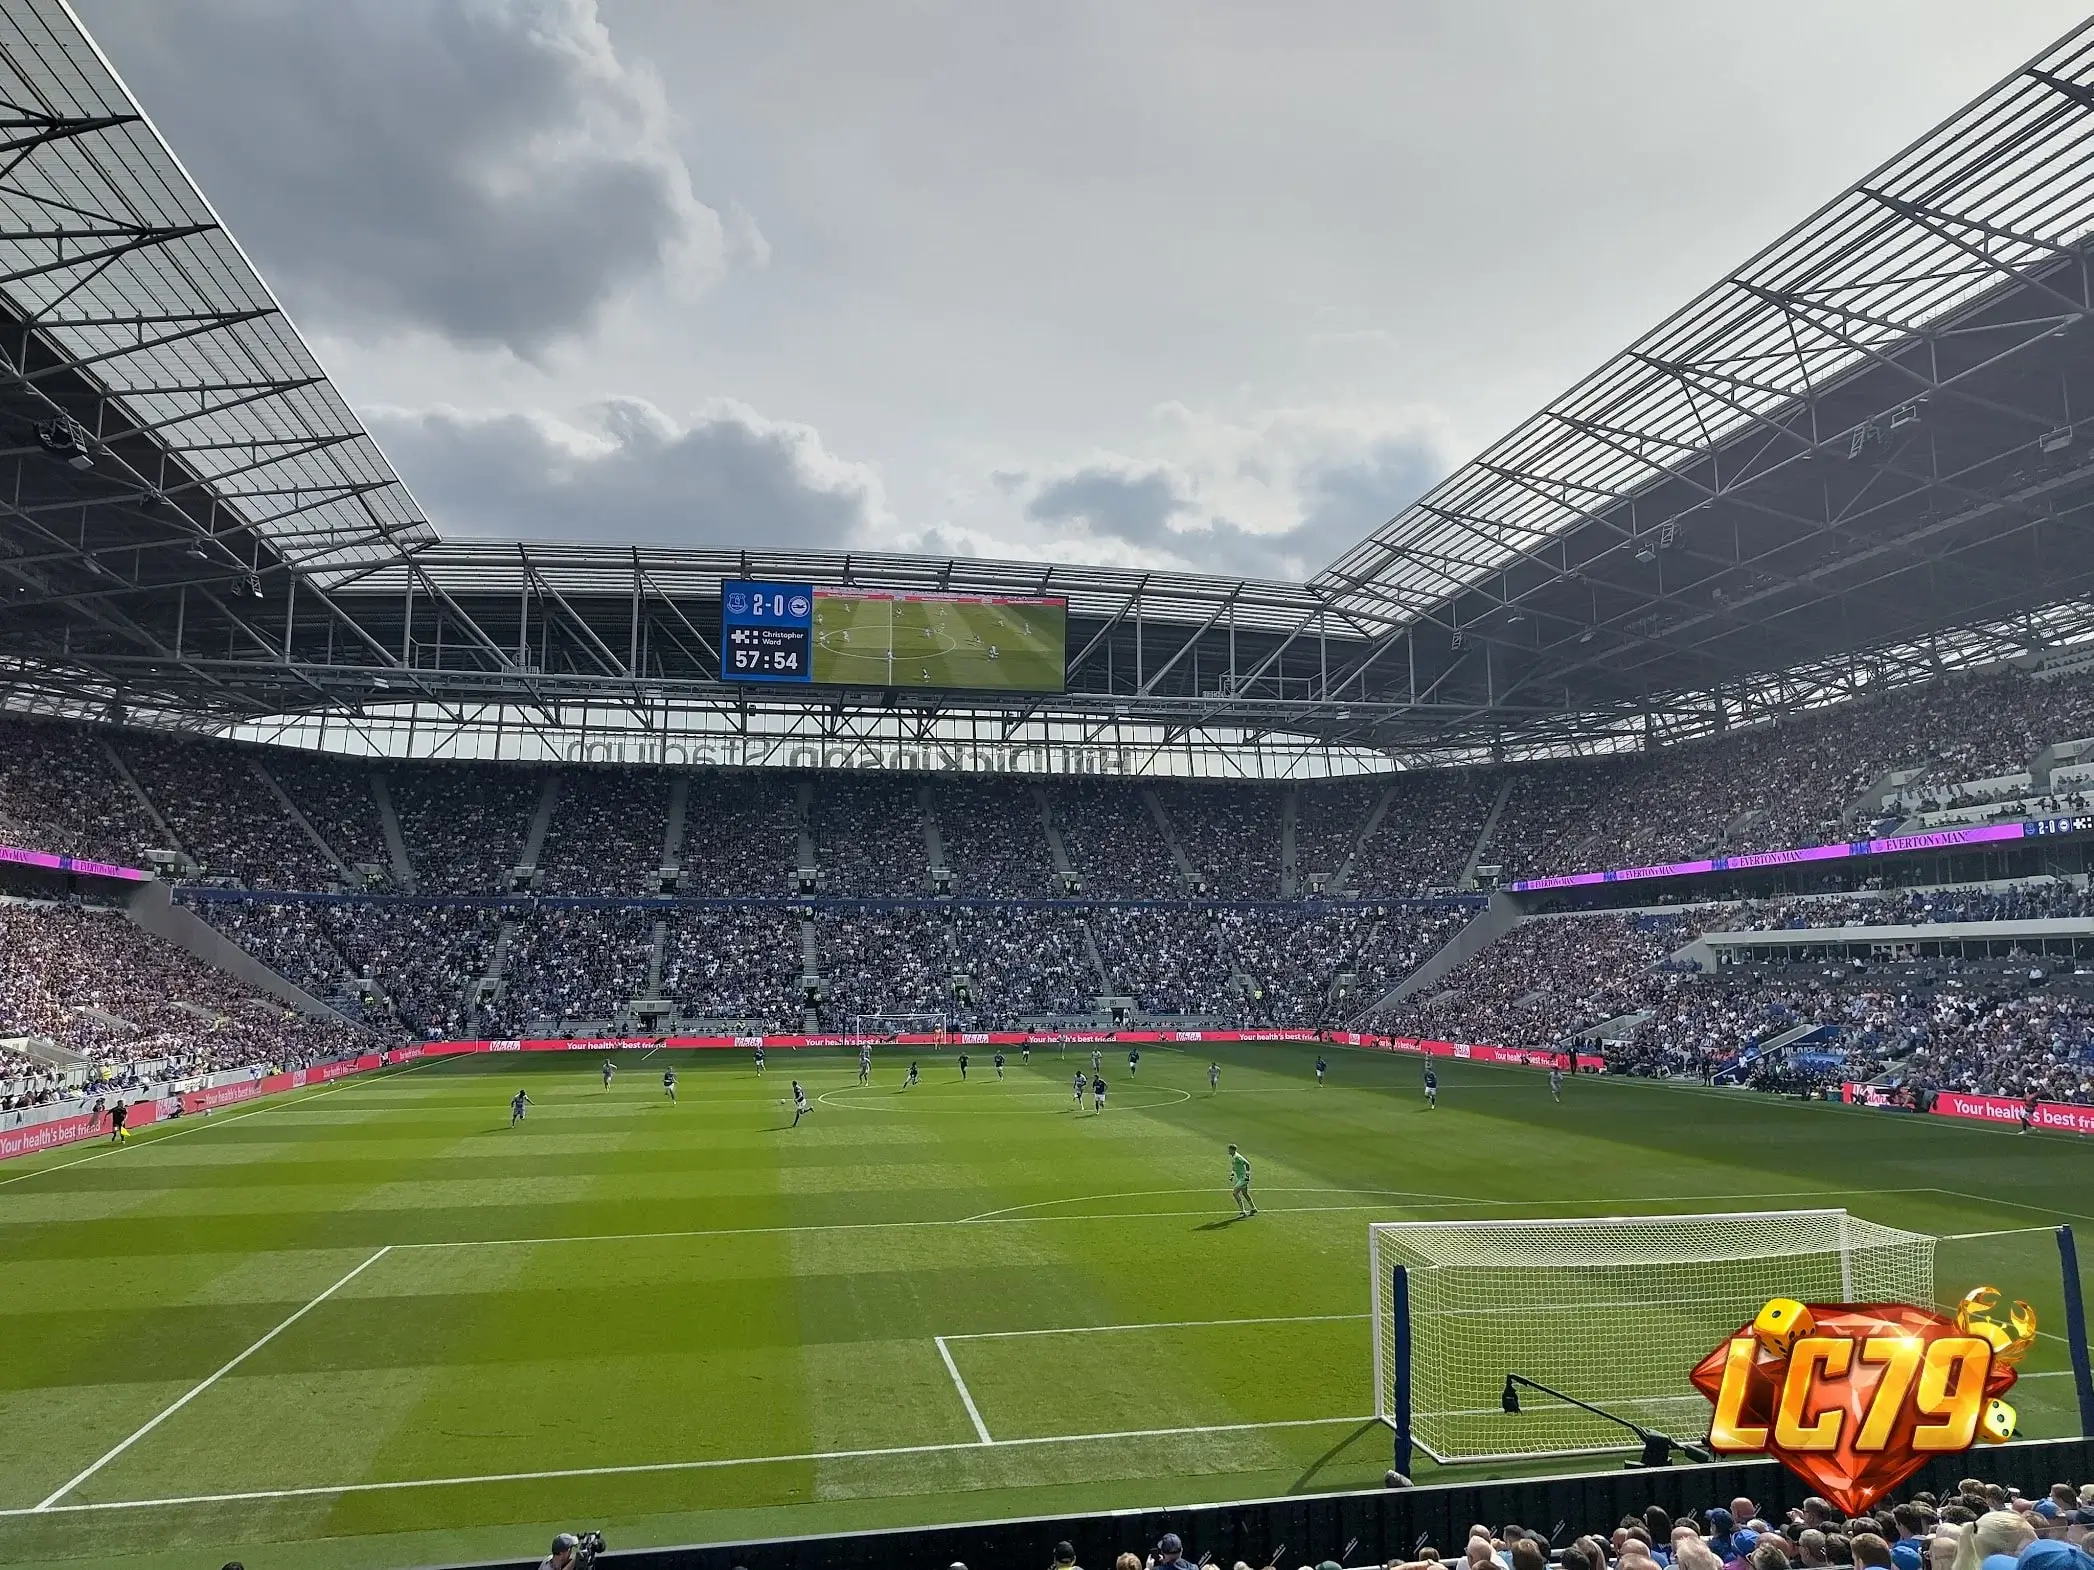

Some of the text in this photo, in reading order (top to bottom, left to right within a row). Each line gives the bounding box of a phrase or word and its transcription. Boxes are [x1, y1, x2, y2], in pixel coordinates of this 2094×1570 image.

[762, 631, 804, 640] Christopher
[735, 650, 798, 669] 57:54
[1886, 835, 1934, 850] EVERTON
[1740, 854, 1776, 866] EVERTON
[1626, 868, 1655, 878] EVERTON
[805, 1038, 824, 1046] Your
[1029, 1035, 1046, 1043] Your
[1077, 1035, 1094, 1043] best
[1239, 1033, 1256, 1041] Your
[1257, 1032, 1284, 1041] health's
[1285, 1032, 1301, 1040] best
[567, 1042, 587, 1050] Your
[622, 1041, 640, 1049] best
[205, 1093, 218, 1105] Your
[218, 1088, 238, 1102] health's
[1953, 1099, 1984, 1115] Your
[2043, 1107, 2076, 1126] best
[0, 1137, 22, 1154] Your
[24, 1128, 57, 1149] health's
[59, 1124, 76, 1141] best
